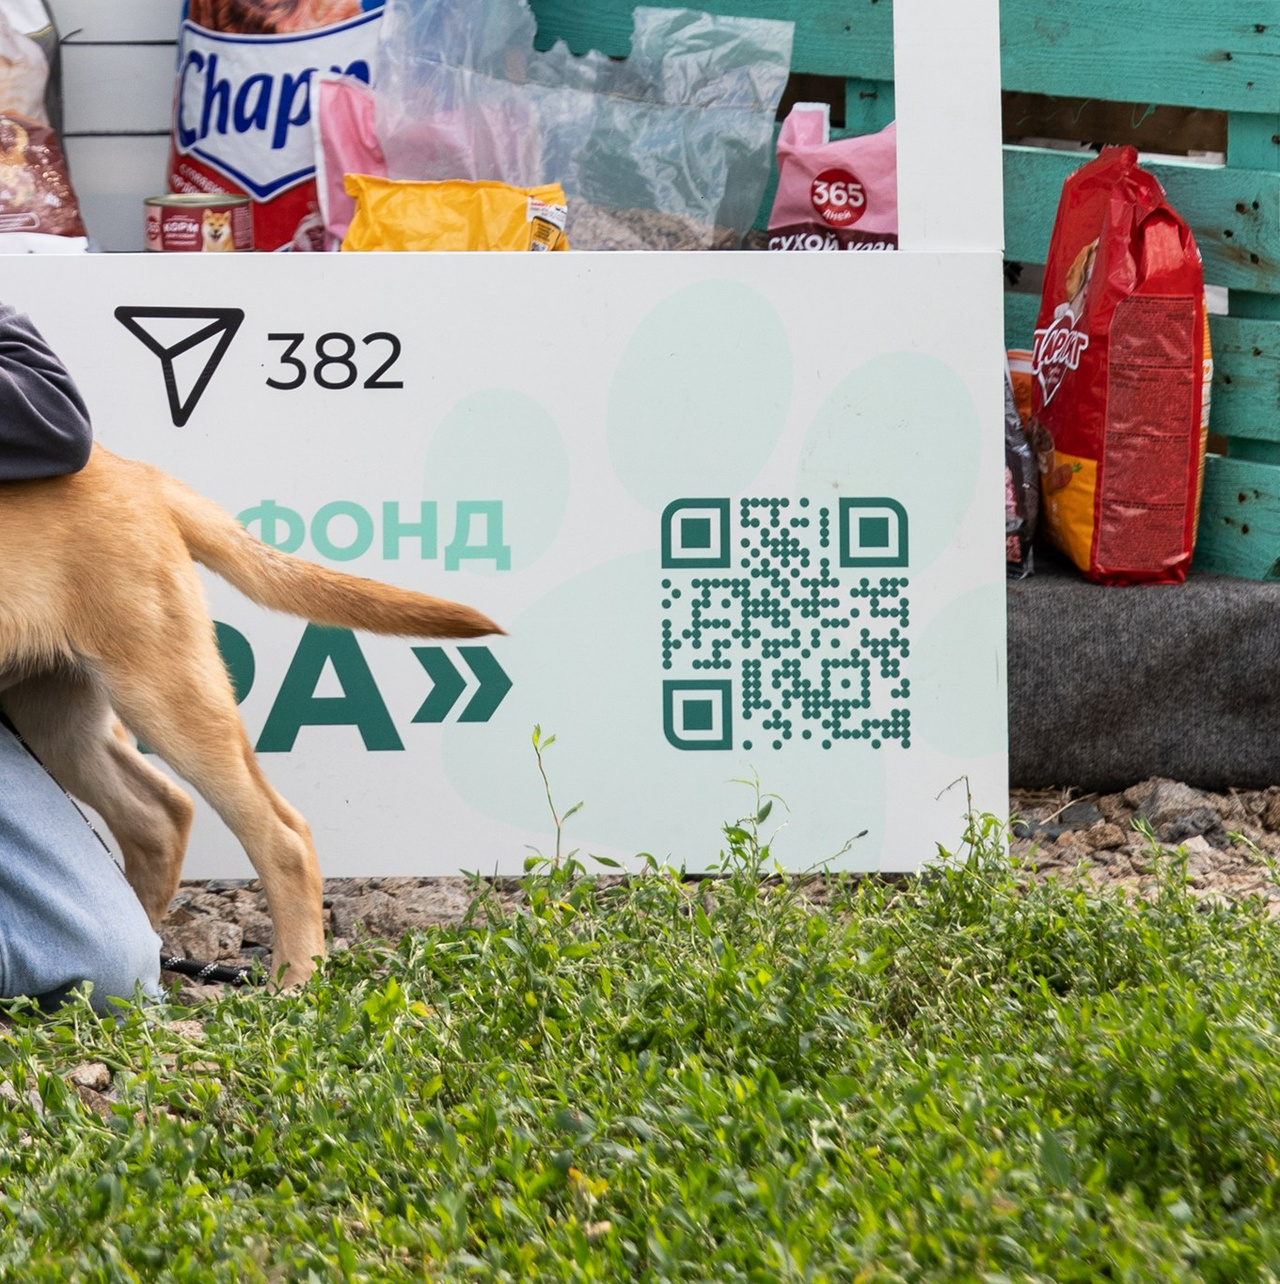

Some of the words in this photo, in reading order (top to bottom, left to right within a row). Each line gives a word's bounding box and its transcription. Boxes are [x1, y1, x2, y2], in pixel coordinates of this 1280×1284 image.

[178, 50, 370, 149] Chap
[812, 180, 864, 207] 365
[266, 332, 405, 391] 382
[235, 500, 511, 571] ФОНД
